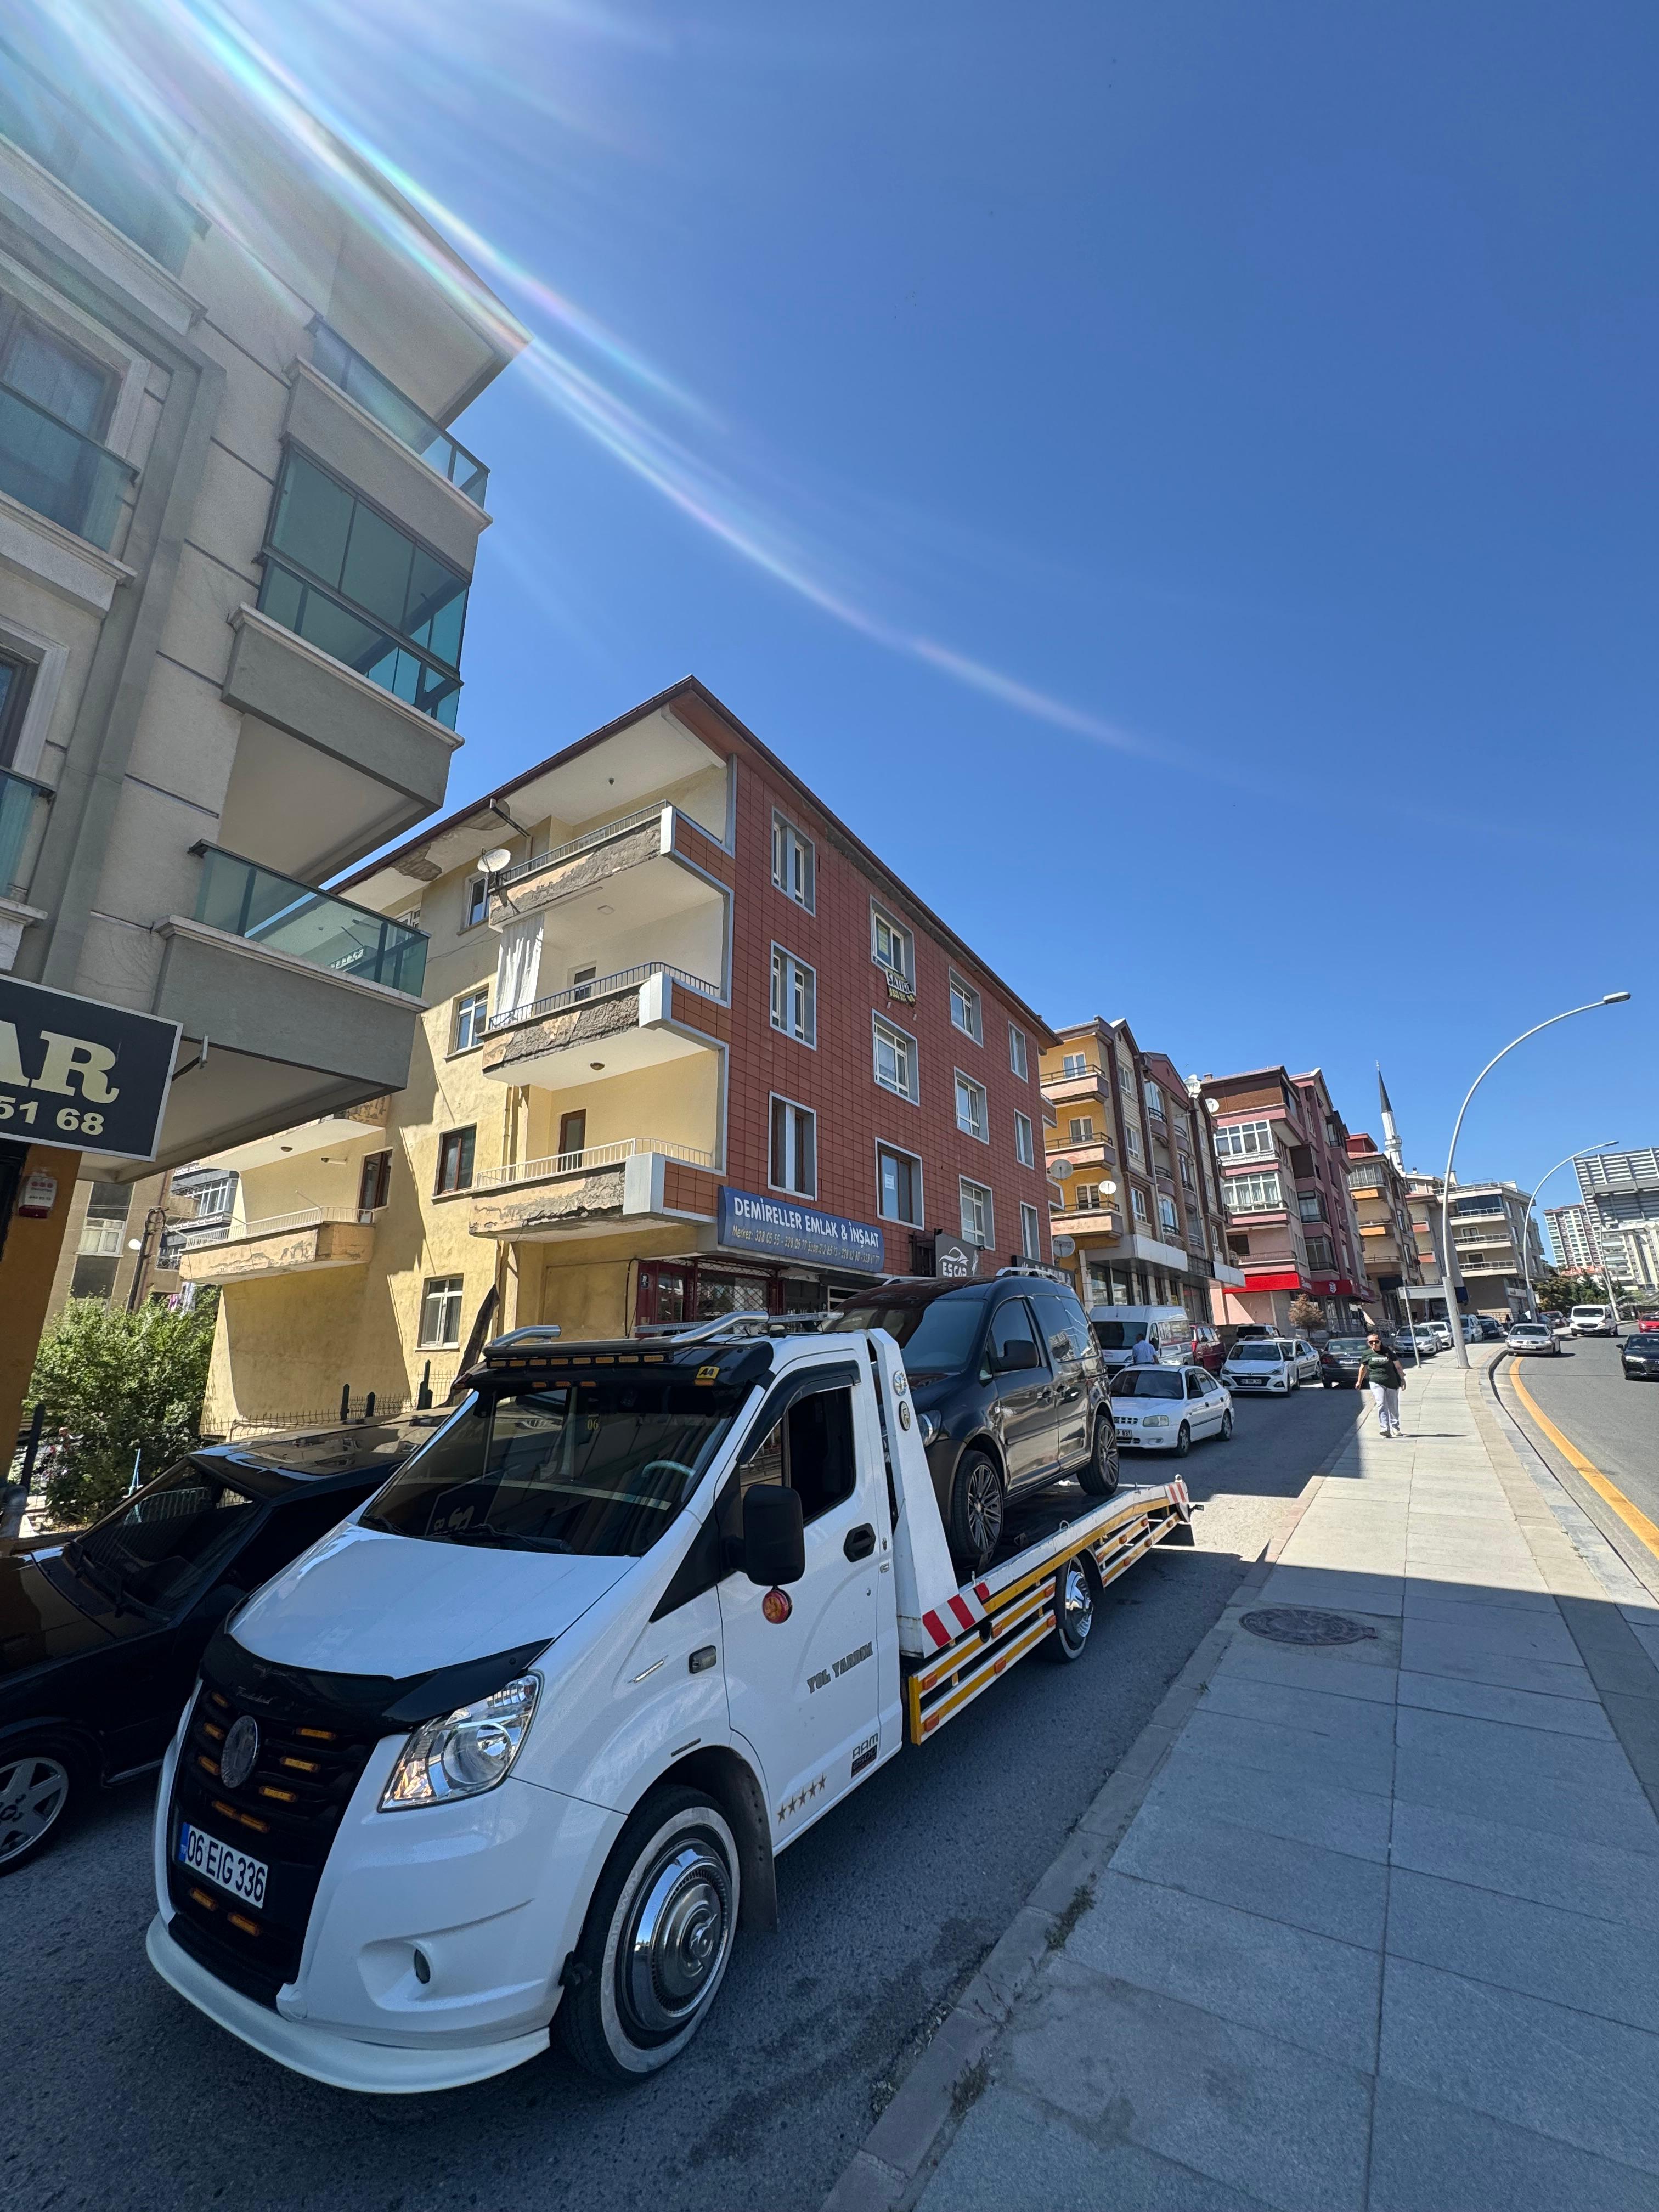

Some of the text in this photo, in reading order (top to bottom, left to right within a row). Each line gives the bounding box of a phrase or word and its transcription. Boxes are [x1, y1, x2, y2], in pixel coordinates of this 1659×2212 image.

[0, 1096, 105, 1136] 51 68
[732, 1224, 753, 1240] Merkez:
[733, 1197, 879, 1248] DEMİRELLER EMLAK & İNŞAAT
[587, 1419, 599, 1431] 06
[806, 1641, 873, 1694] YOL YARDIM
[187, 1830, 266, 1903] 06 EIG 336
